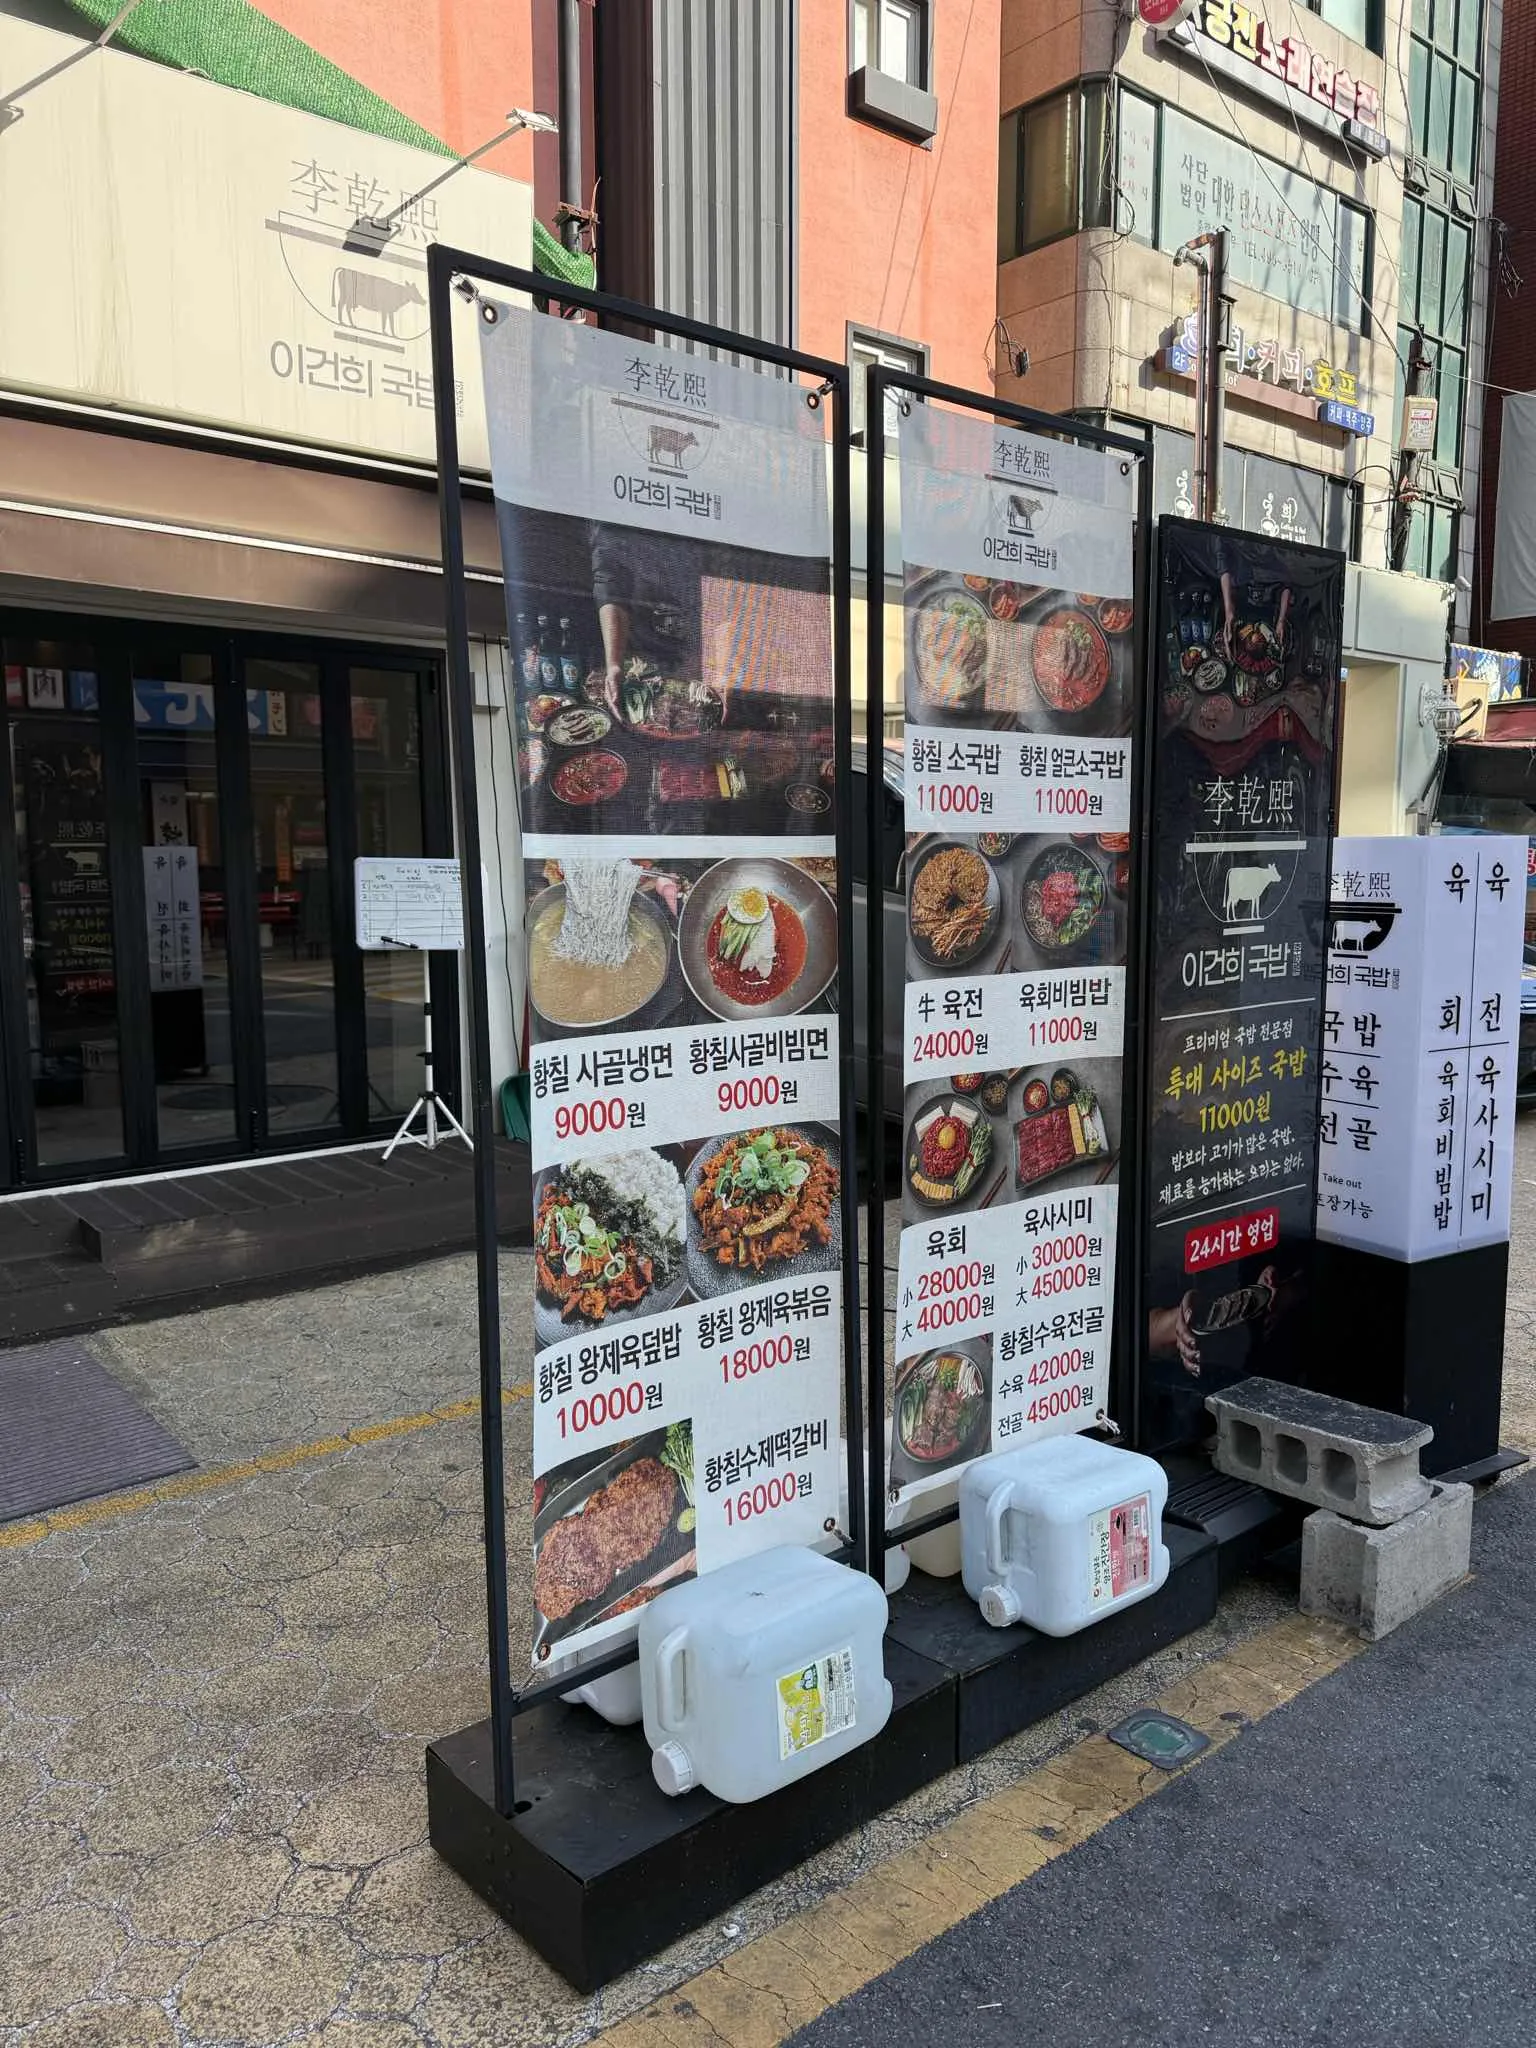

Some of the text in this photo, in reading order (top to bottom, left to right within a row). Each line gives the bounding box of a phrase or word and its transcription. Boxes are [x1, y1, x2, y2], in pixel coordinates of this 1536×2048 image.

[1181, 153, 1208, 185] 사단
[270, 340, 374, 399] 이건희
[1174, 351, 1186, 368] 2F
[623, 356, 708, 408] 李乾熙
[993, 439, 1051, 479] 李乾熙
[613, 474, 671, 511] 이건희
[674, 485, 714, 518] 국밥
[983, 537, 1023, 564] 이건희
[1024, 542, 1052, 569] 국밥
[911, 738, 1002, 775] 황칠 소국밥
[1018, 744, 1126, 780] 황칠 얼큰소국밥
[917, 784, 993, 815] 11000원
[1035, 787, 1103, 816] 11000원
[1203, 774, 1294, 826] 李乾熙
[1182, 946, 1245, 987] 이건희
[1249, 942, 1291, 979] 국밥
[1354, 965, 1391, 988] 국밥
[918, 987, 983, 1023] 牛 육전
[1019, 977, 1112, 1013] 육회비빔밥
[689, 1027, 829, 1075] 황칠사골비빔면
[913, 1028, 988, 1063] 24000원
[1029, 1015, 1097, 1047] 11000원
[1183, 1018, 1294, 1054] 프리미엄 국밥 전문점
[533, 1041, 673, 1099] 황칠 사골냉면
[1164, 1046, 1308, 1101] 특대 사이즈 국밥
[718, 1074, 799, 1112] 9000원
[1199, 1090, 1272, 1133] 11000원
[555, 1096, 646, 1140] 9000원
[1471, 1057, 1501, 1222] 육사시미
[1171, 1145, 1207, 1172] 밥보다
[1209, 1137, 1244, 1163] 고기가
[1246, 1133, 1267, 1156] 많은
[1434, 1060, 1460, 1232] 육회비빔밥
[1159, 1178, 1196, 1206] 재료를
[1199, 1167, 1246, 1197] 능가하는
[1247, 1159, 1282, 1184] 요리는
[1323, 1173, 1363, 1190] Take out
[1023, 1197, 1093, 1236] 육사시미
[1189, 1214, 1275, 1263] 24시간 영업
[926, 1224, 967, 1259] 육회
[1015, 1233, 1102, 1276] 小 30000원
[902, 1261, 995, 1308] 小 28000원
[1015, 1263, 1101, 1307] 大 45000원
[698, 1284, 832, 1350] 황칠 왕제육볶음
[902, 1294, 995, 1342] 大 40000원
[1000, 1306, 1104, 1361] 황칠수육전골
[538, 1322, 682, 1404] 황칠 왕제육덮밥
[719, 1334, 811, 1384] 18000원
[998, 1348, 1094, 1400] 수육 42000원
[556, 1381, 663, 1440] 10000원
[998, 1384, 1093, 1438] 전골 45000원
[704, 1419, 828, 1493] 황칠수제떡갈비
[723, 1472, 813, 1527] 16000원
